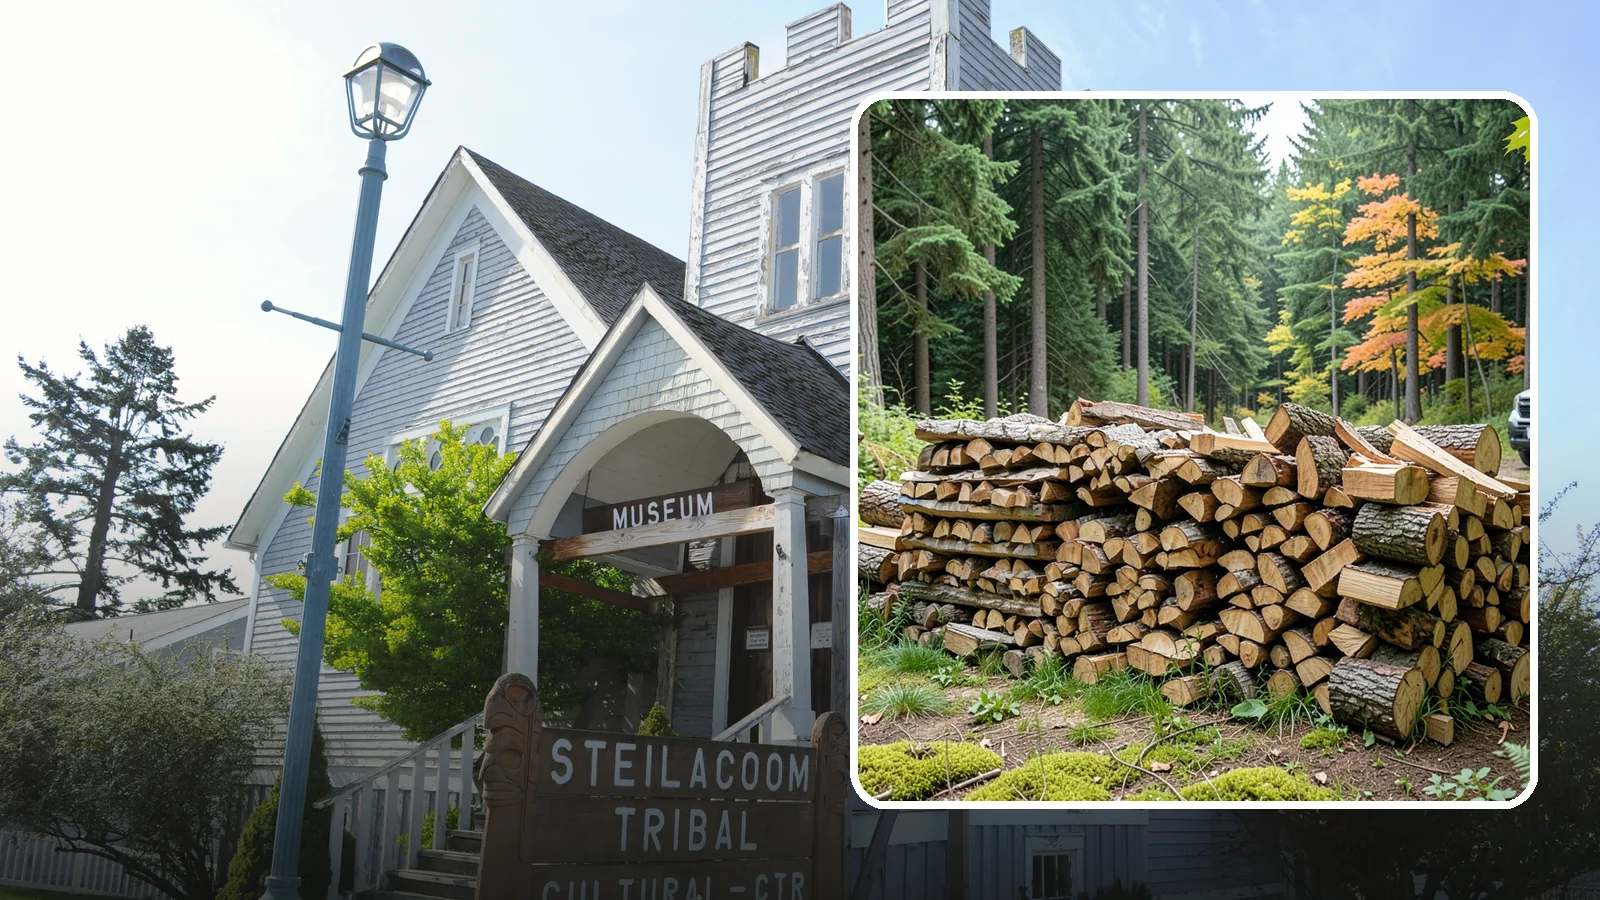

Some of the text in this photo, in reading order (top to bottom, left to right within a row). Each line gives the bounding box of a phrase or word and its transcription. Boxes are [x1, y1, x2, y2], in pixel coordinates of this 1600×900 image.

[613, 491, 714, 531] MUSEUM
[550, 738, 809, 792] STEILACOOM
[615, 806, 758, 852] TRIBAL
